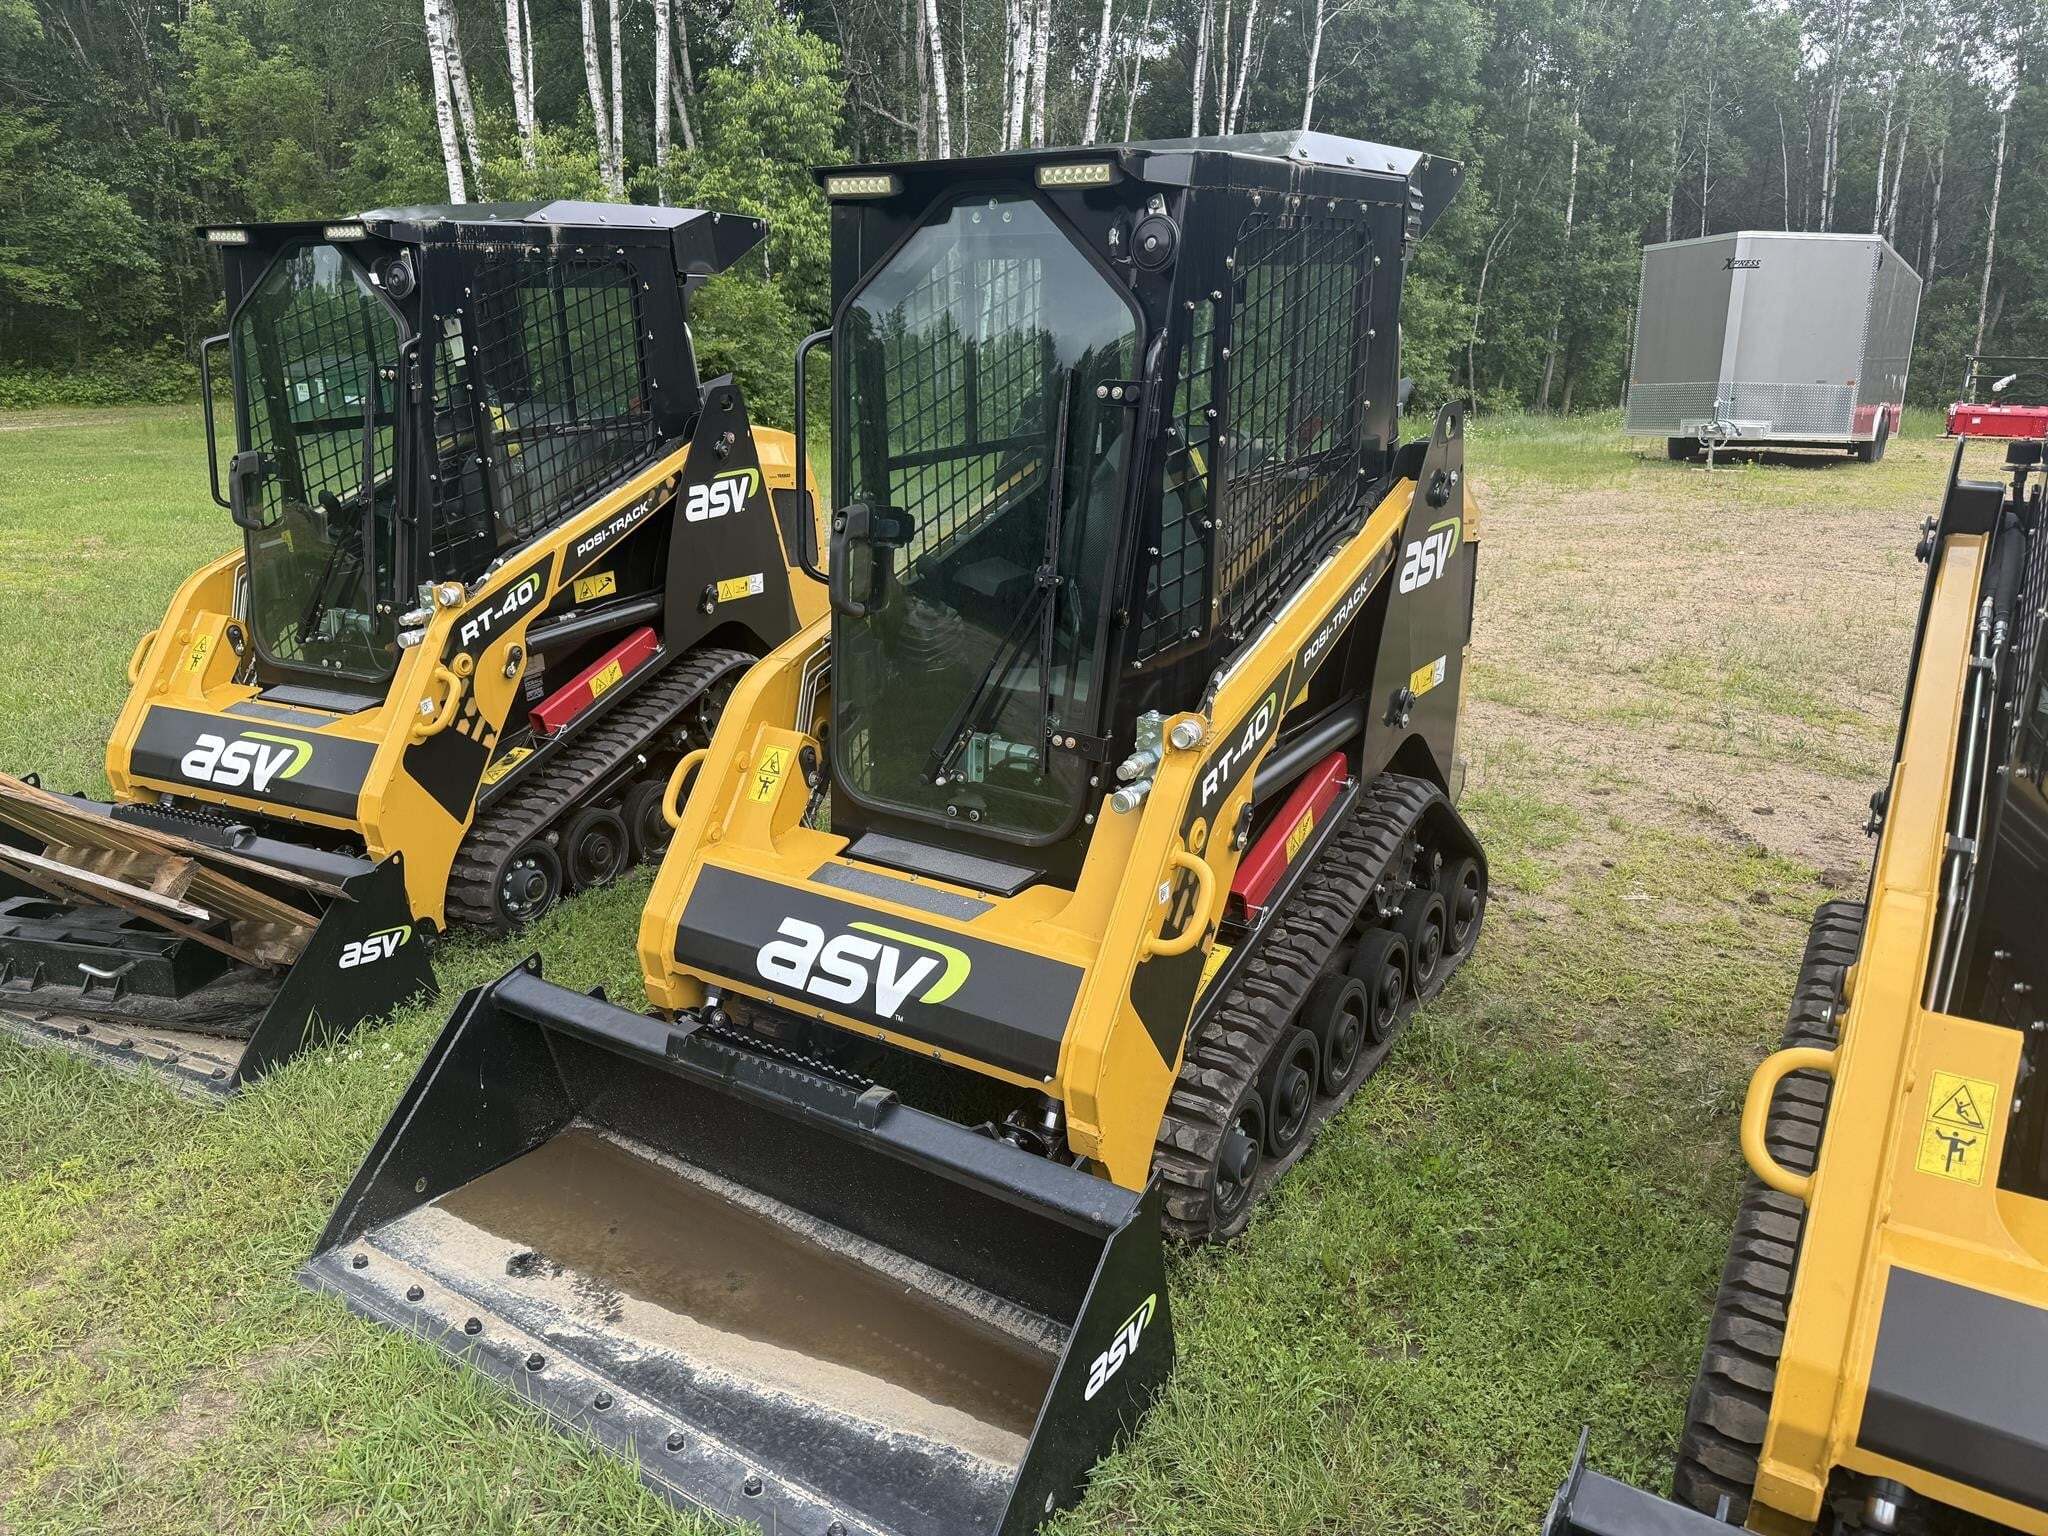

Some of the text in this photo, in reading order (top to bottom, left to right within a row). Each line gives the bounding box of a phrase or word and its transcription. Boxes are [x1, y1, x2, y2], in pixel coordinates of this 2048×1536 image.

[577, 500, 649, 557] POSI-TRACK
[461, 581, 533, 646] RT-40
[1303, 577, 1367, 668] POSI-TRACK
[1202, 706, 1269, 807] RT-40
